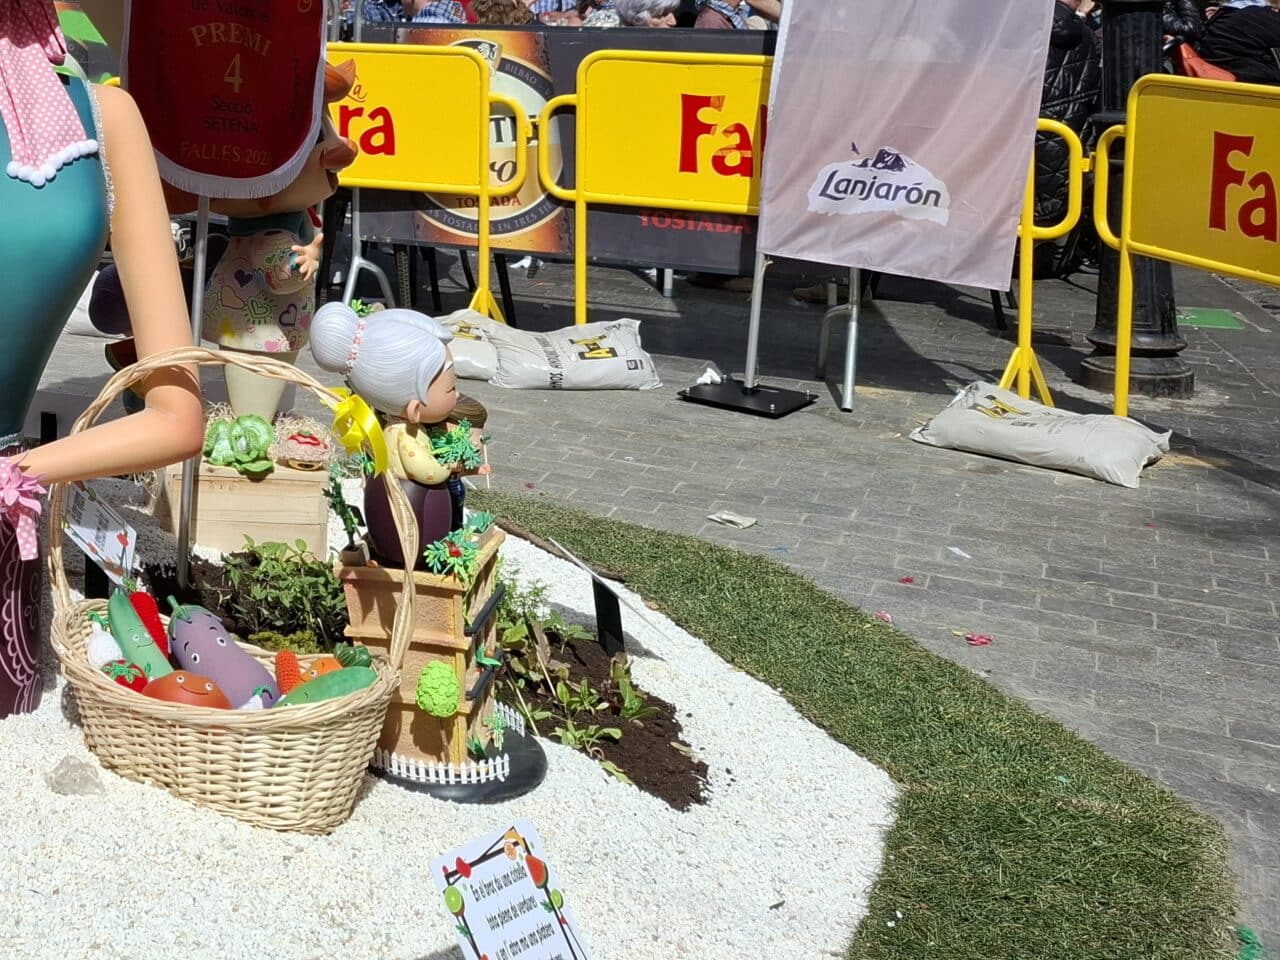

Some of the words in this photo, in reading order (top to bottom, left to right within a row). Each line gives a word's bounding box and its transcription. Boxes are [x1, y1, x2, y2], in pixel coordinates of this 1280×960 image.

[190, 22, 272, 56] PREMI
[224, 53, 244, 93] 4
[505, 63, 537, 85] BILBAO
[181, 141, 241, 162] FALLES
[818, 170, 941, 207] Lanjarón
[1209, 130, 1278, 243] Fa
[514, 212, 537, 225] TRES
[470, 884, 480, 902] En
[501, 873, 513, 887] una
[498, 907, 514, 929] plena
